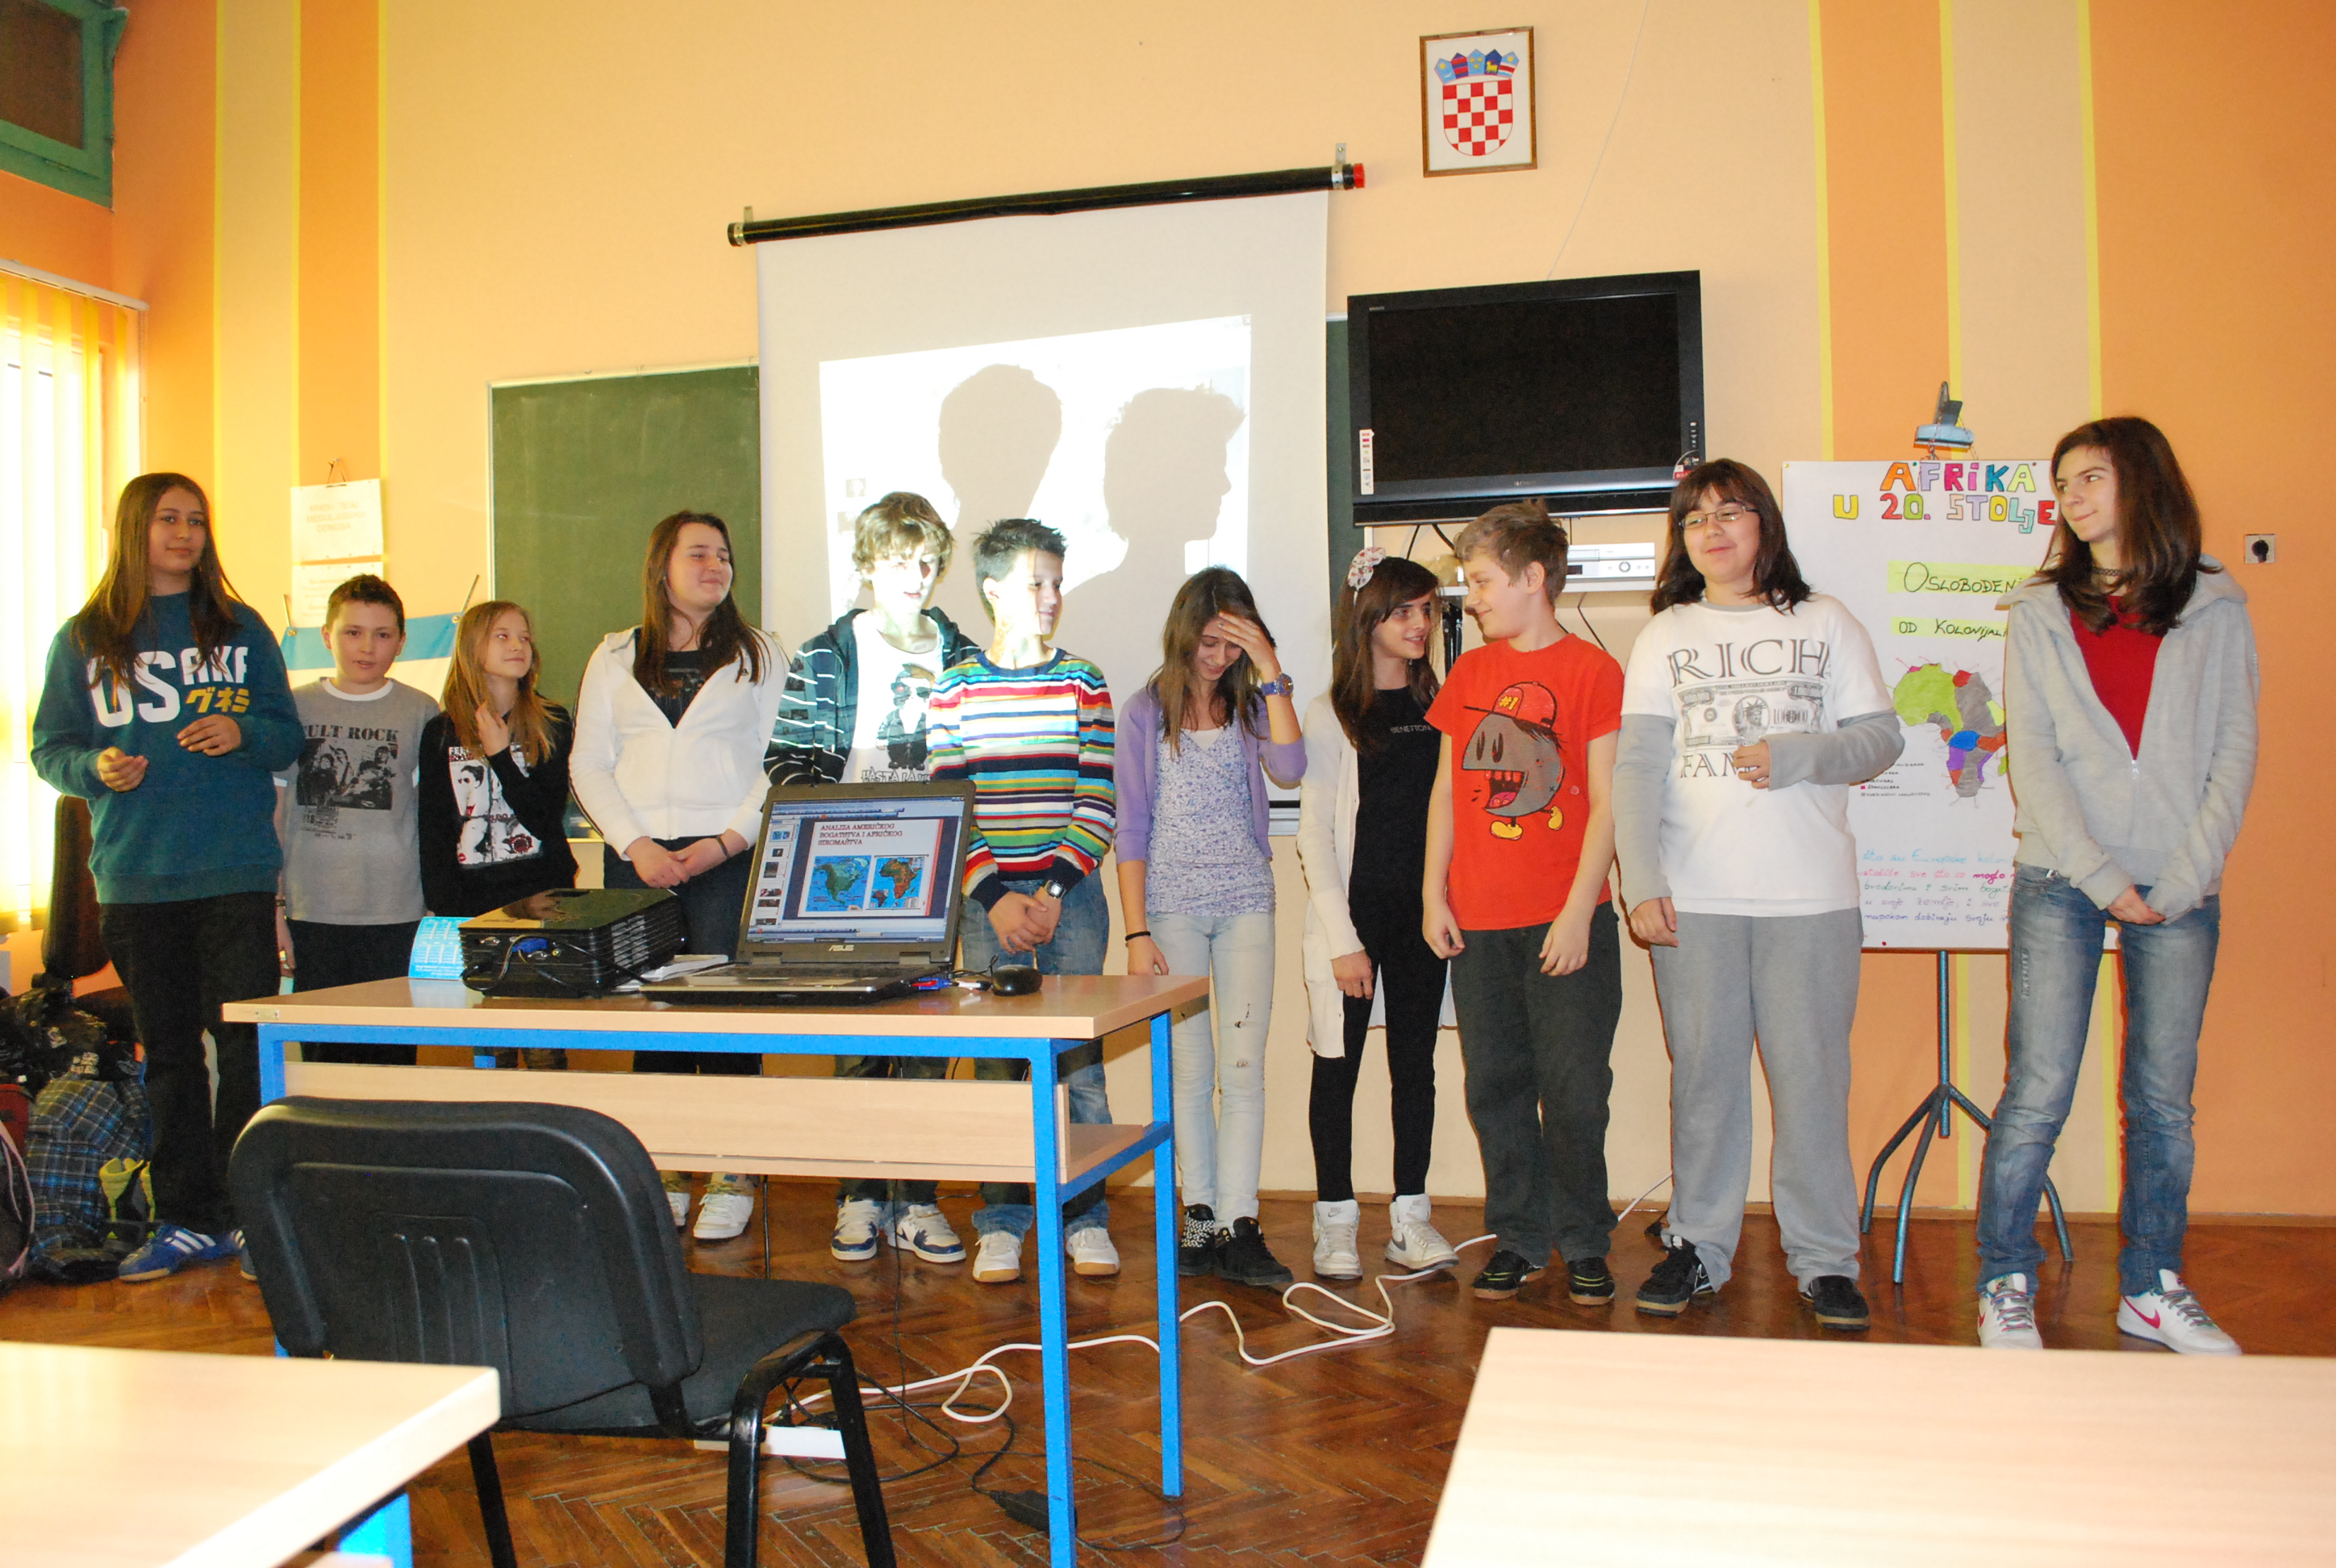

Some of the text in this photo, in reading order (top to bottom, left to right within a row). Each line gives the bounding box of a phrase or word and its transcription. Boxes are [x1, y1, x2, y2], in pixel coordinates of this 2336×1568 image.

[1833, 493, 2057, 534] U 20. STOLJE
[1899, 621, 1917, 634] OD
[1666, 637, 1830, 688] RICH
[1499, 695, 1519, 711] #1
[305, 724, 398, 742] ULT ROCK
[1679, 752, 1738, 778] FAM
[1979, 881, 2011, 899] bogat
